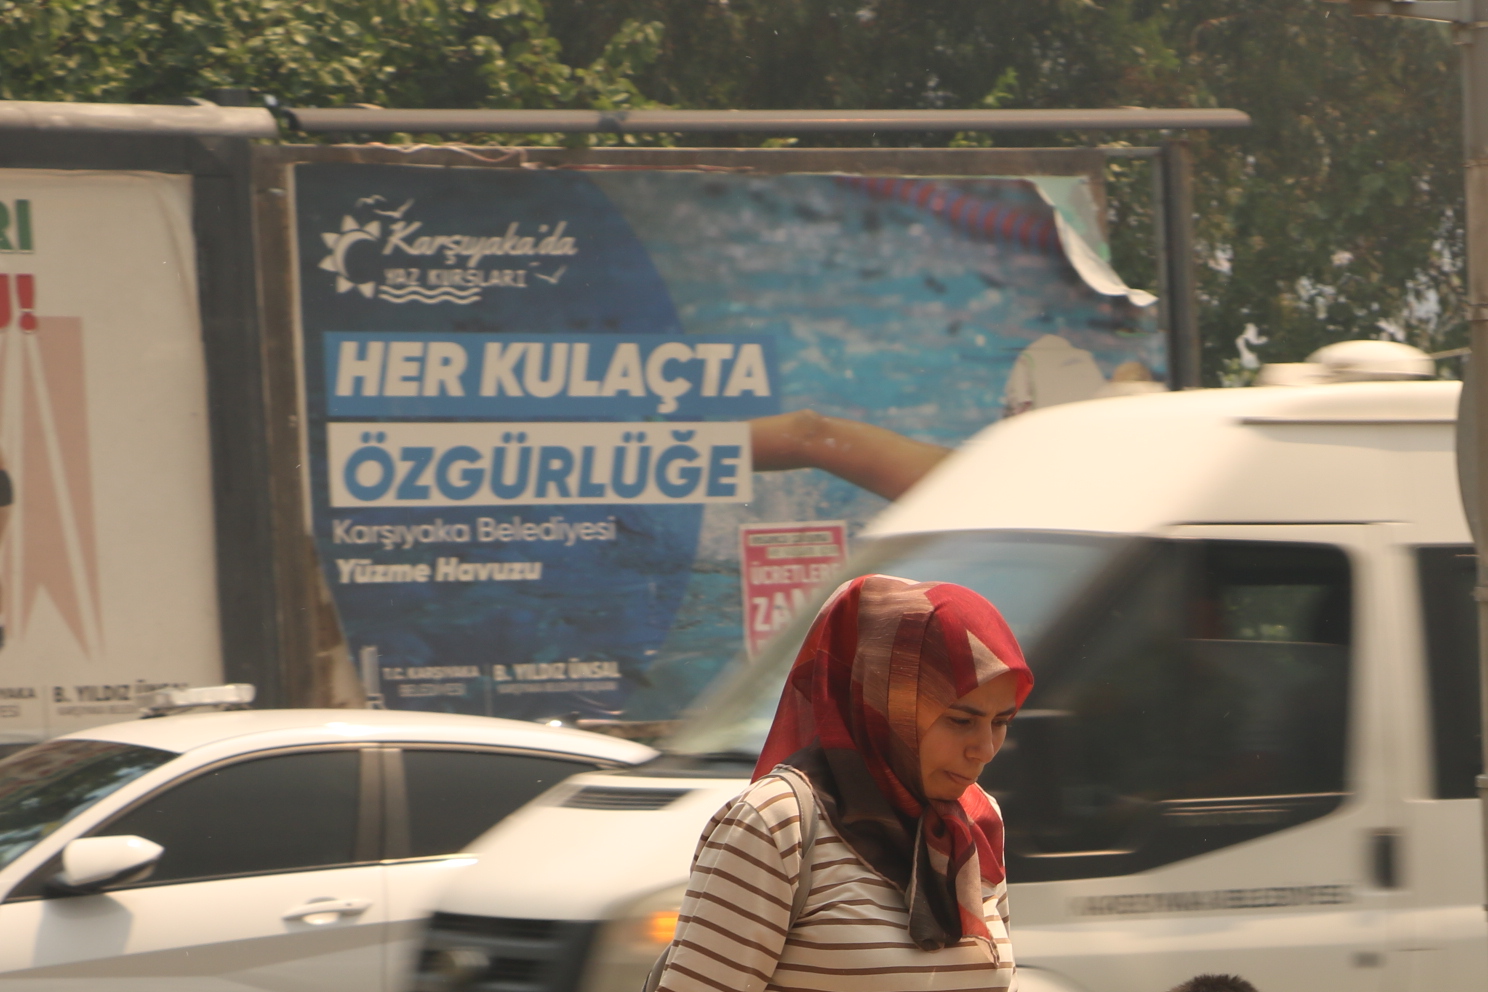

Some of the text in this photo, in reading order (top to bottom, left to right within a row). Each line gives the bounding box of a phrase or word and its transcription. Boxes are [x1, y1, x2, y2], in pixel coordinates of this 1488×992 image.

[384, 268, 527, 287] YAZ KURSLARI
[335, 341, 771, 413] HER KULAÇTA
[343, 430, 743, 501] ÖZGÜRLÜĞE
[332, 516, 616, 550] Karşıyaka Belediyesi
[335, 557, 542, 583] Yüzme Havuzu
